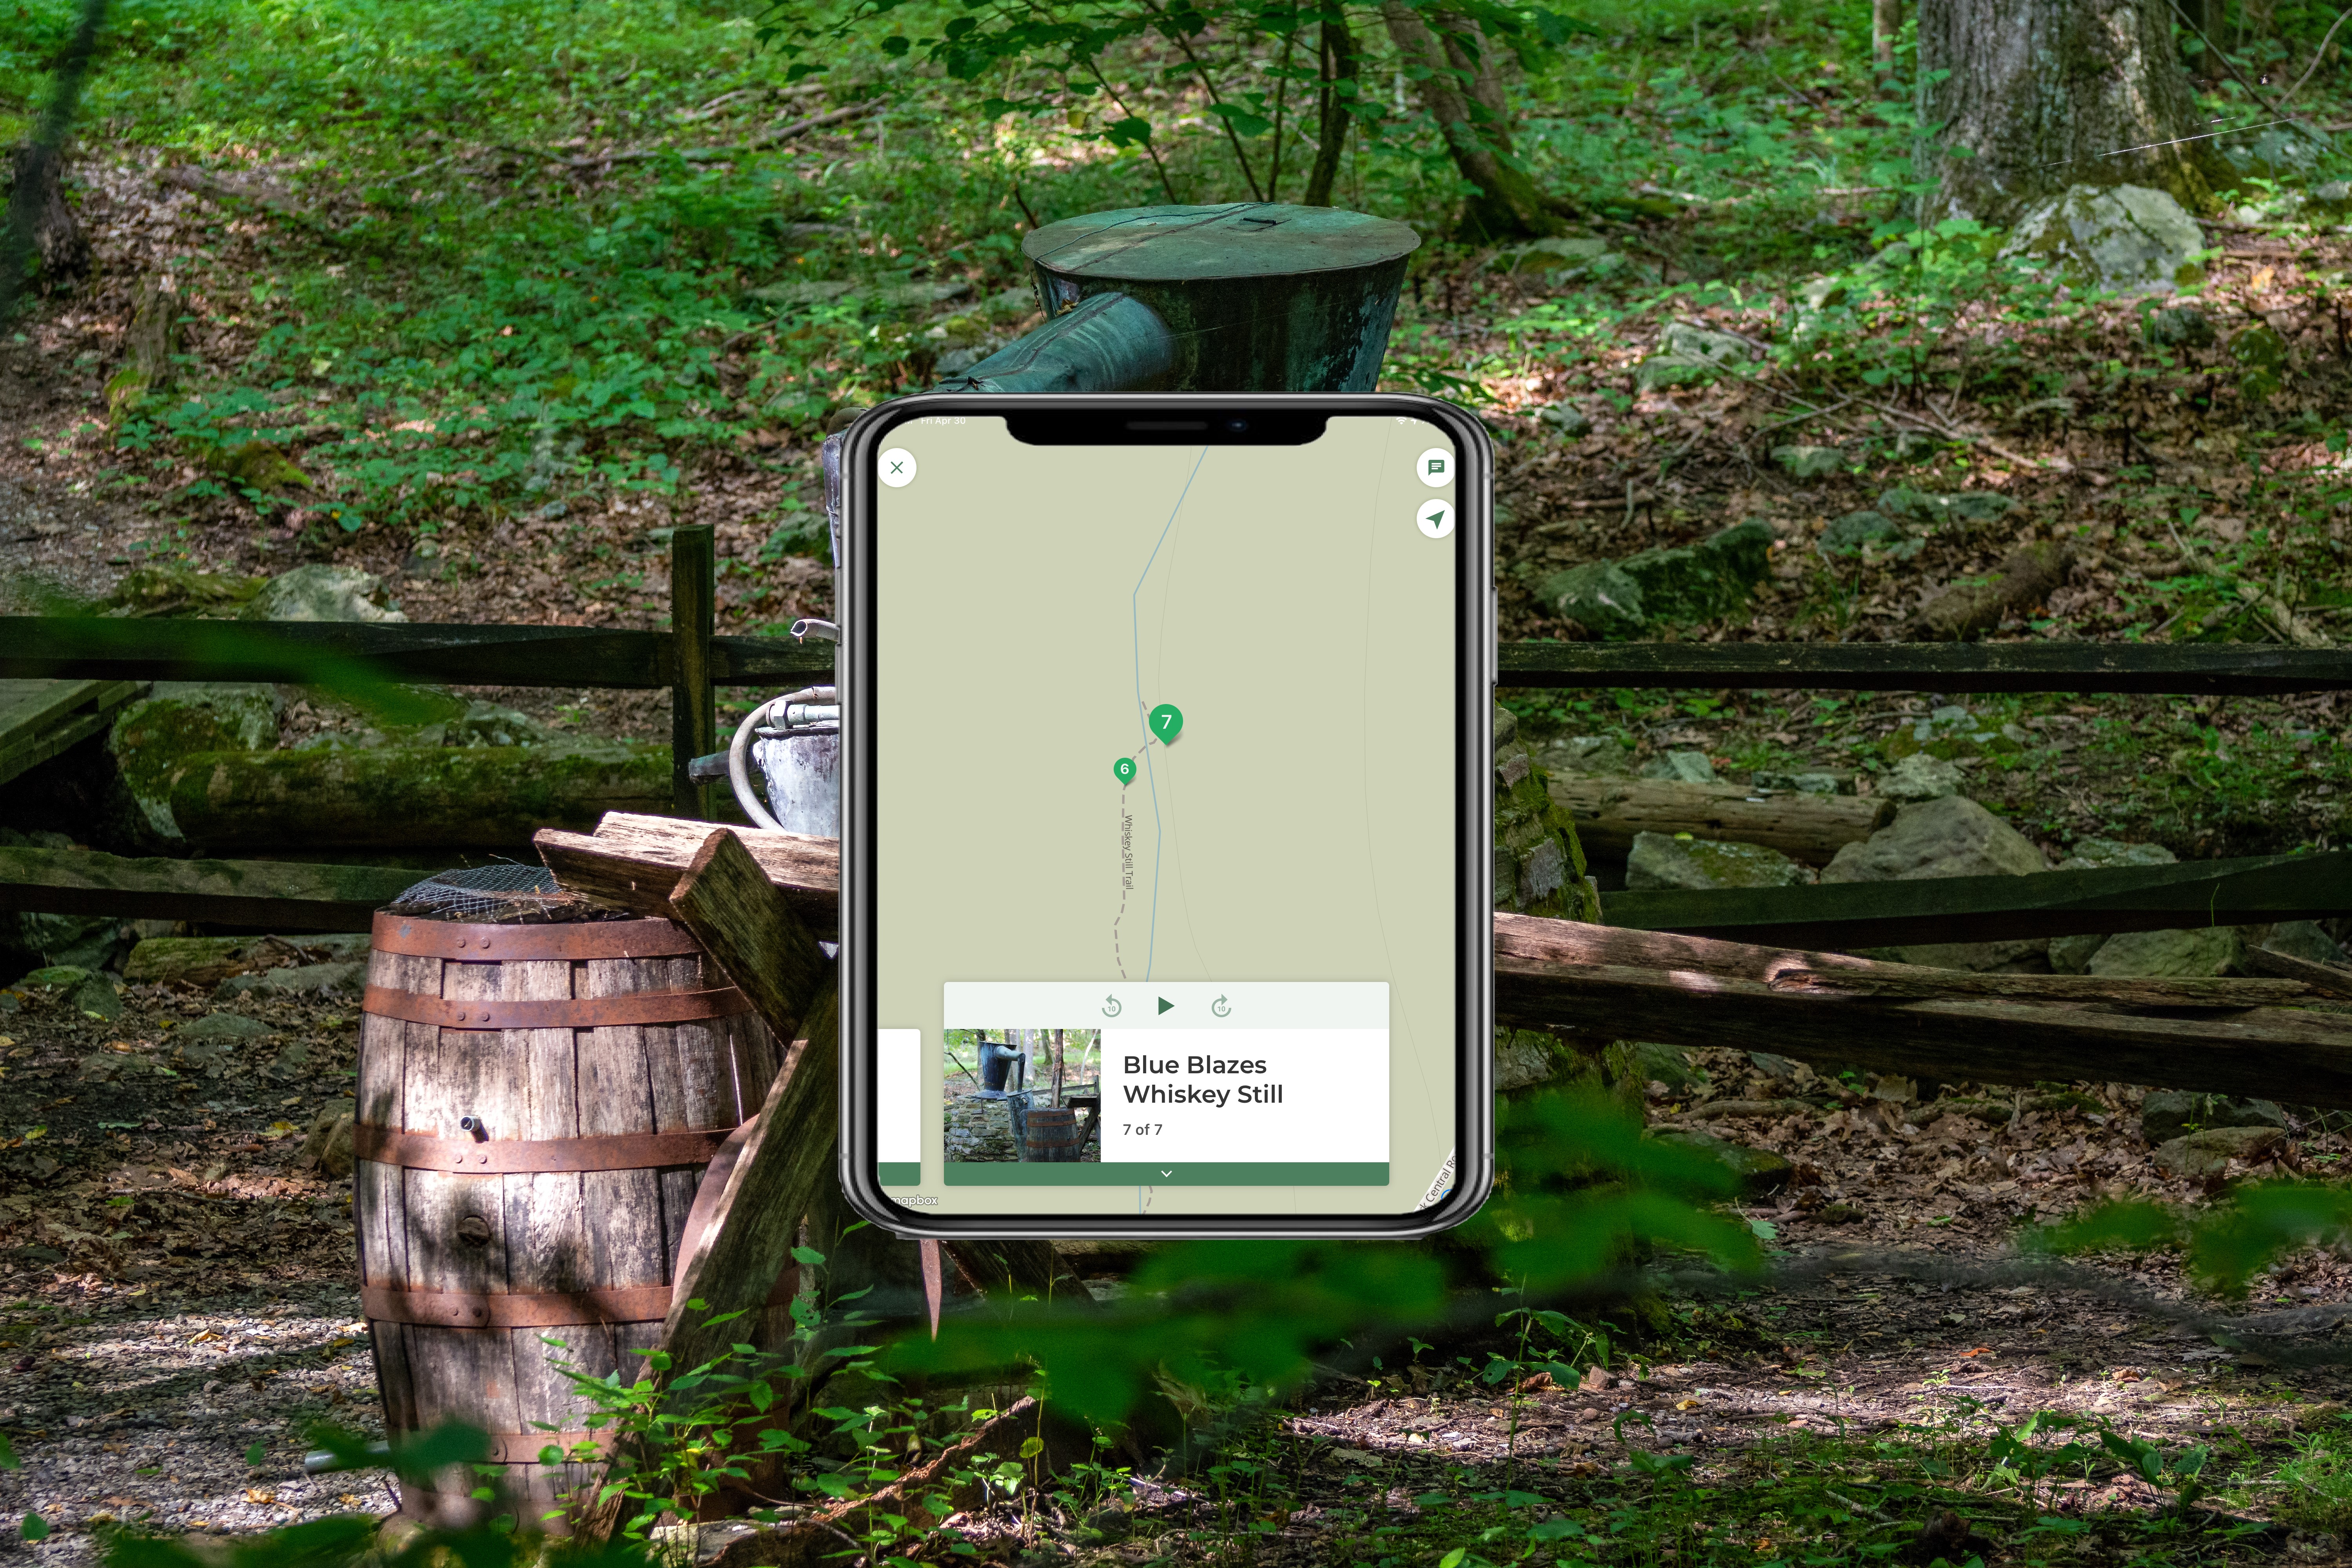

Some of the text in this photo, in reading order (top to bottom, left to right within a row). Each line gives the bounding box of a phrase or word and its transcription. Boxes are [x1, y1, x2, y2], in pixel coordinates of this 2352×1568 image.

[935, 417, 951, 426] Apr
[1161, 715, 1172, 729] 7
[1120, 763, 1129, 775] 6
[1122, 815, 1134, 889] Whiskey Still Trail
[1125, 1055, 1267, 1074] Blue Blazes
[1123, 1083, 1282, 1108] Whiskey Still
[1123, 1123, 1163, 1136] 7 of 7
[1426, 1168, 1451, 1202] Central
